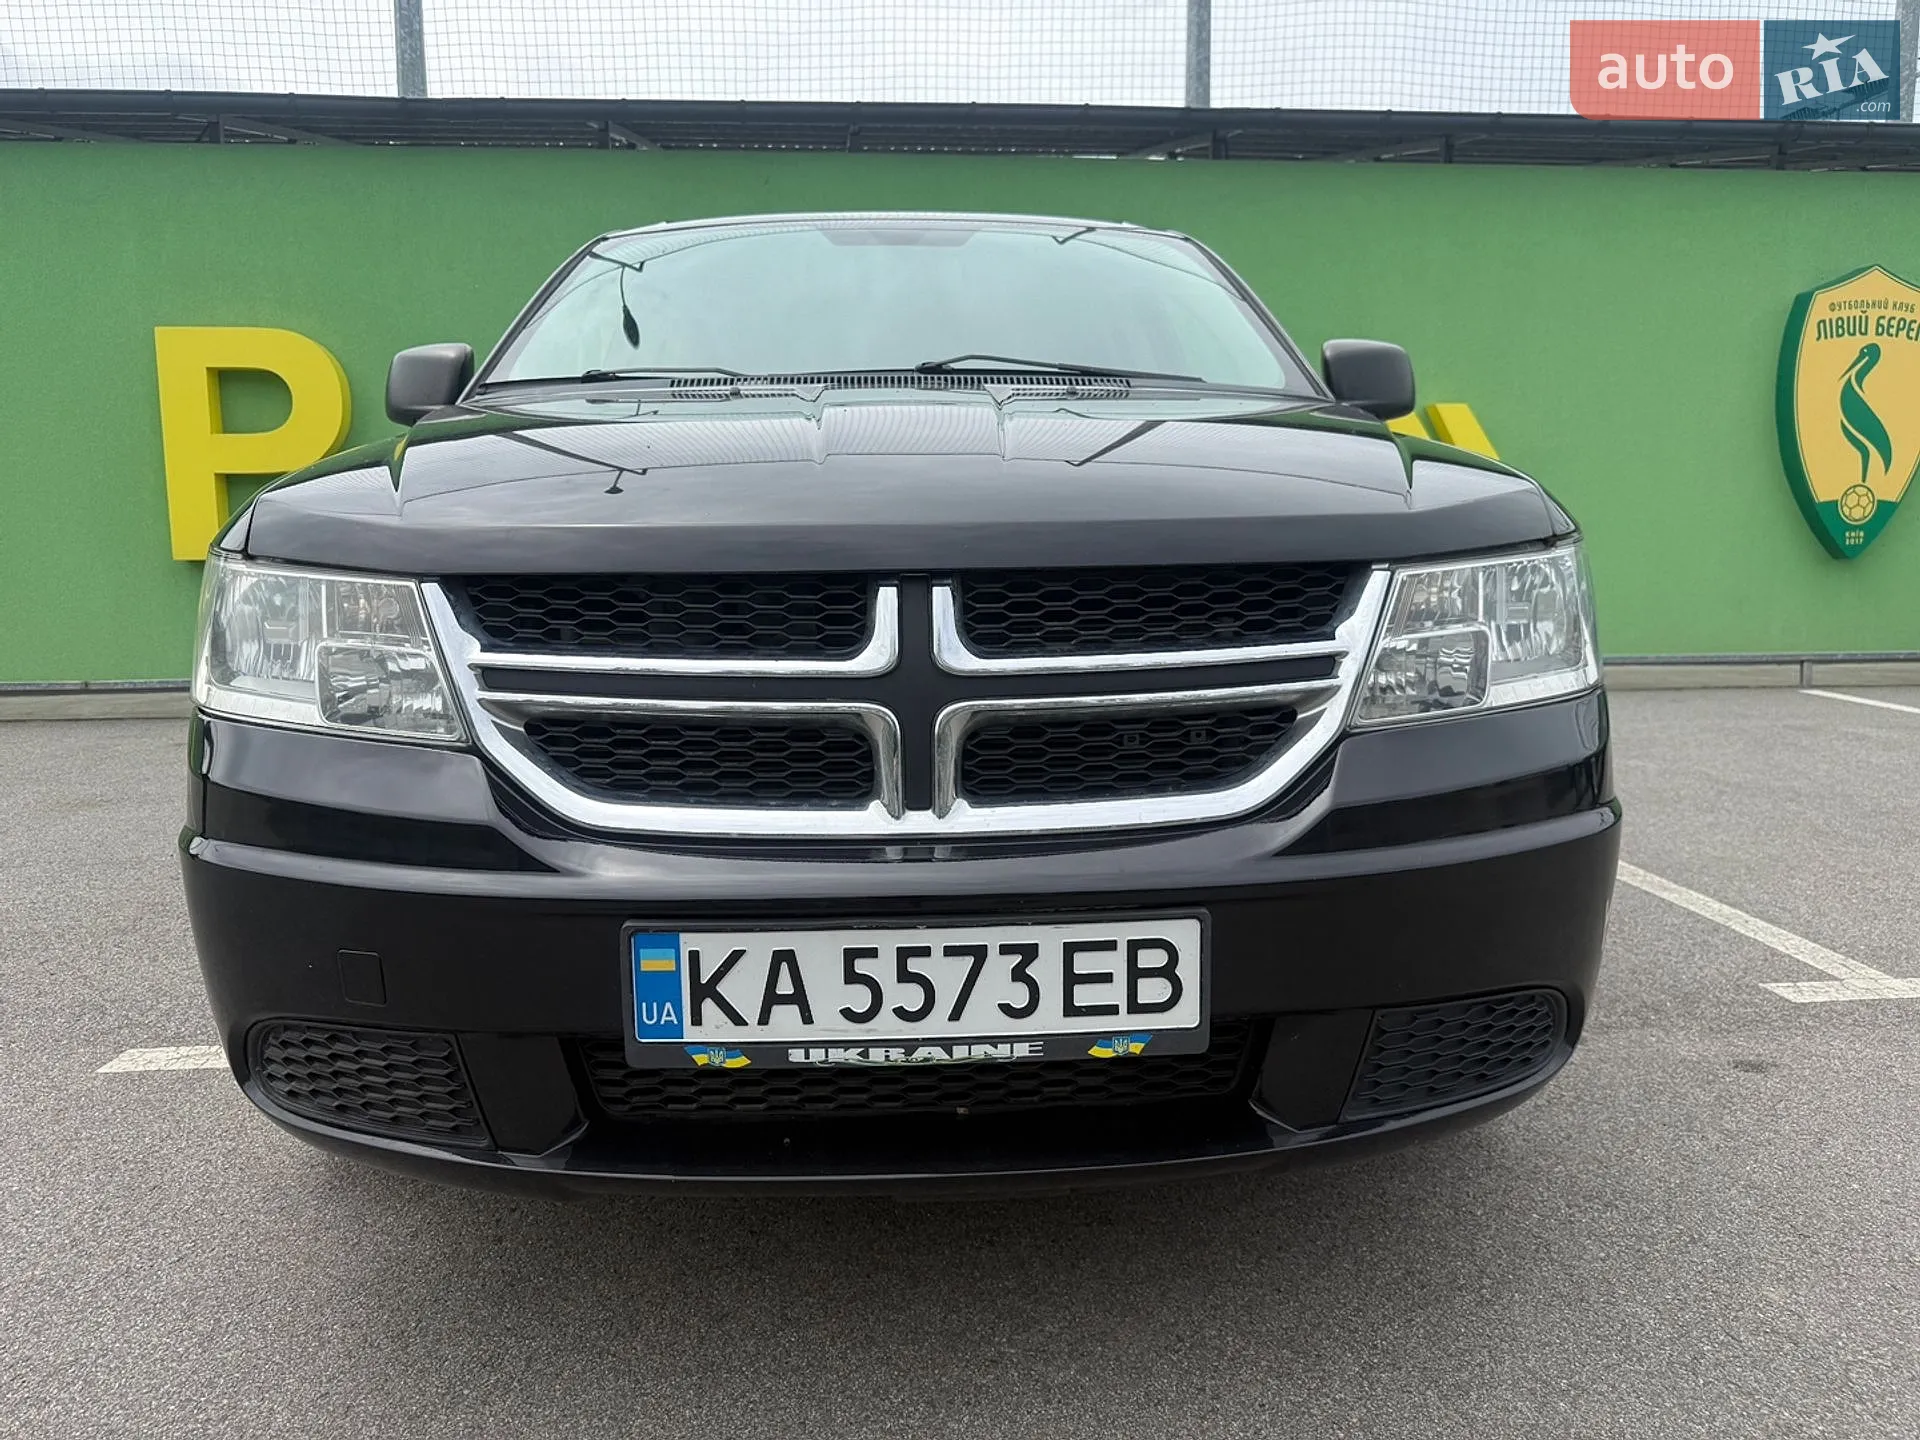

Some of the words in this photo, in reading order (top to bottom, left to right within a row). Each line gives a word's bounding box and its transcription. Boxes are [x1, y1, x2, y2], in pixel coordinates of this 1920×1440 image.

[1828, 297, 1889, 312] ФУТБОЛЬНИЙ
[1892, 300, 1916, 314] КЛУБ
[1816, 310, 1869, 342] ЛІВИЙ
[687, 947, 814, 1027] KA
[838, 942, 1041, 1024] 5573
[1062, 937, 1183, 1018] EB
[641, 1001, 678, 1026] UA
[788, 1041, 1044, 1064] UKRAINE
